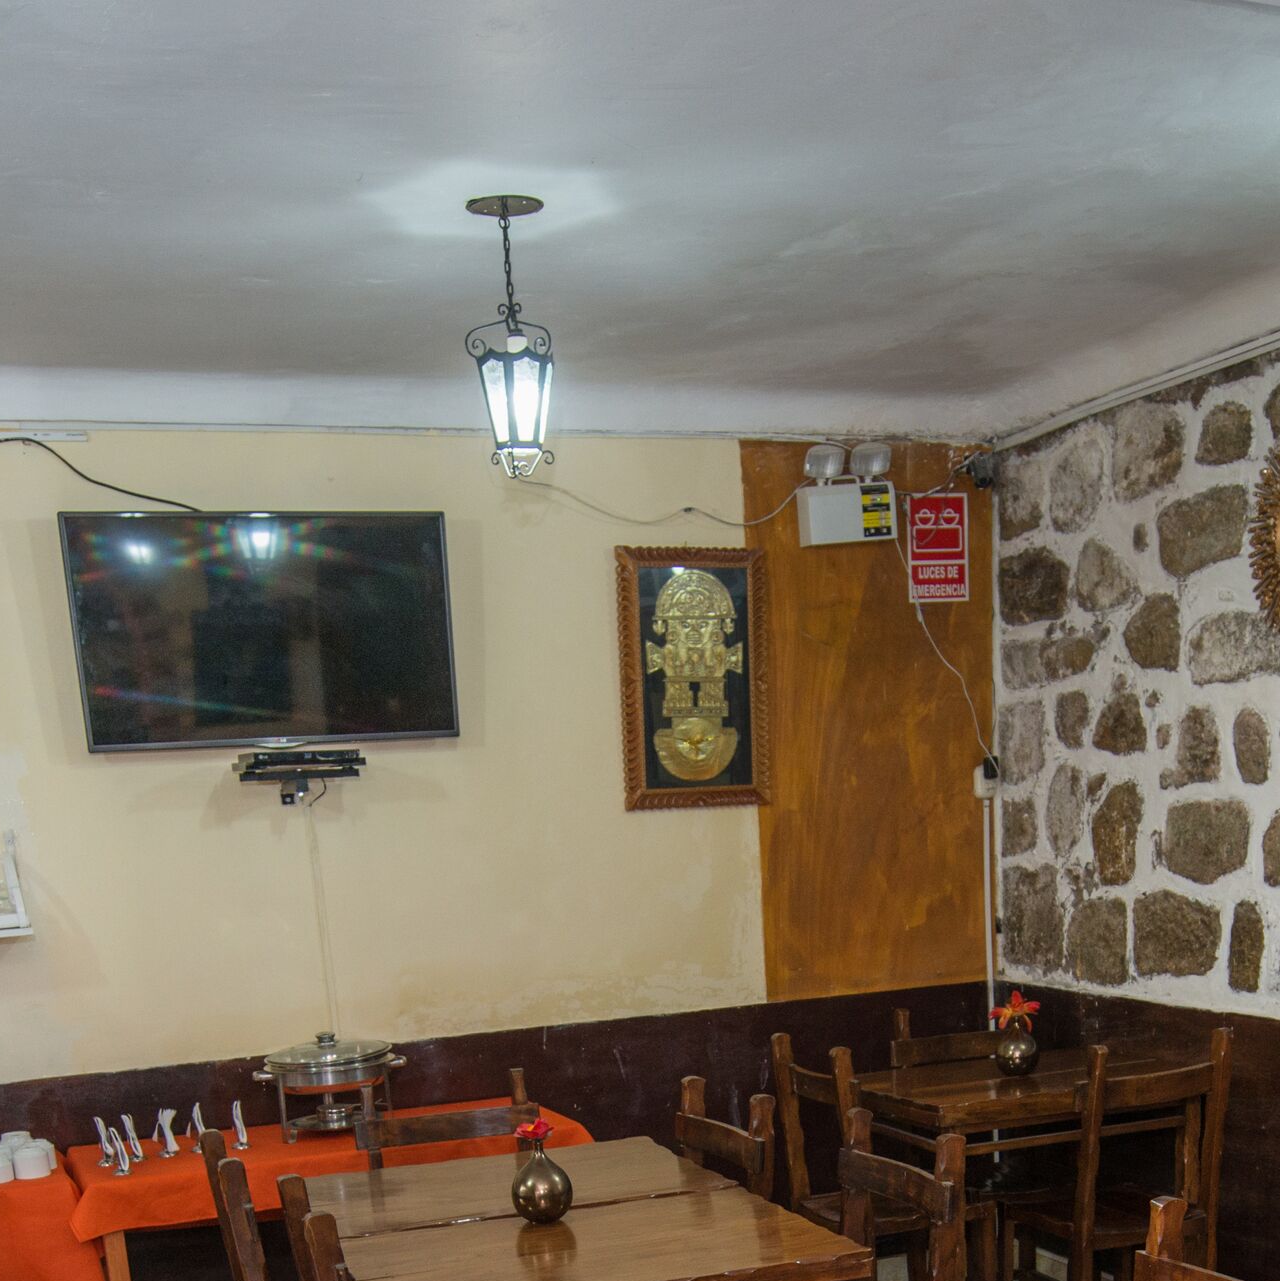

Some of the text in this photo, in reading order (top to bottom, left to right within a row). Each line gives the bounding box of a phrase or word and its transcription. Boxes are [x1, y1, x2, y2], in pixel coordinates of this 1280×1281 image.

[918, 565, 959, 579] LUCES DE
[912, 584, 966, 597] EMERGENCIA
